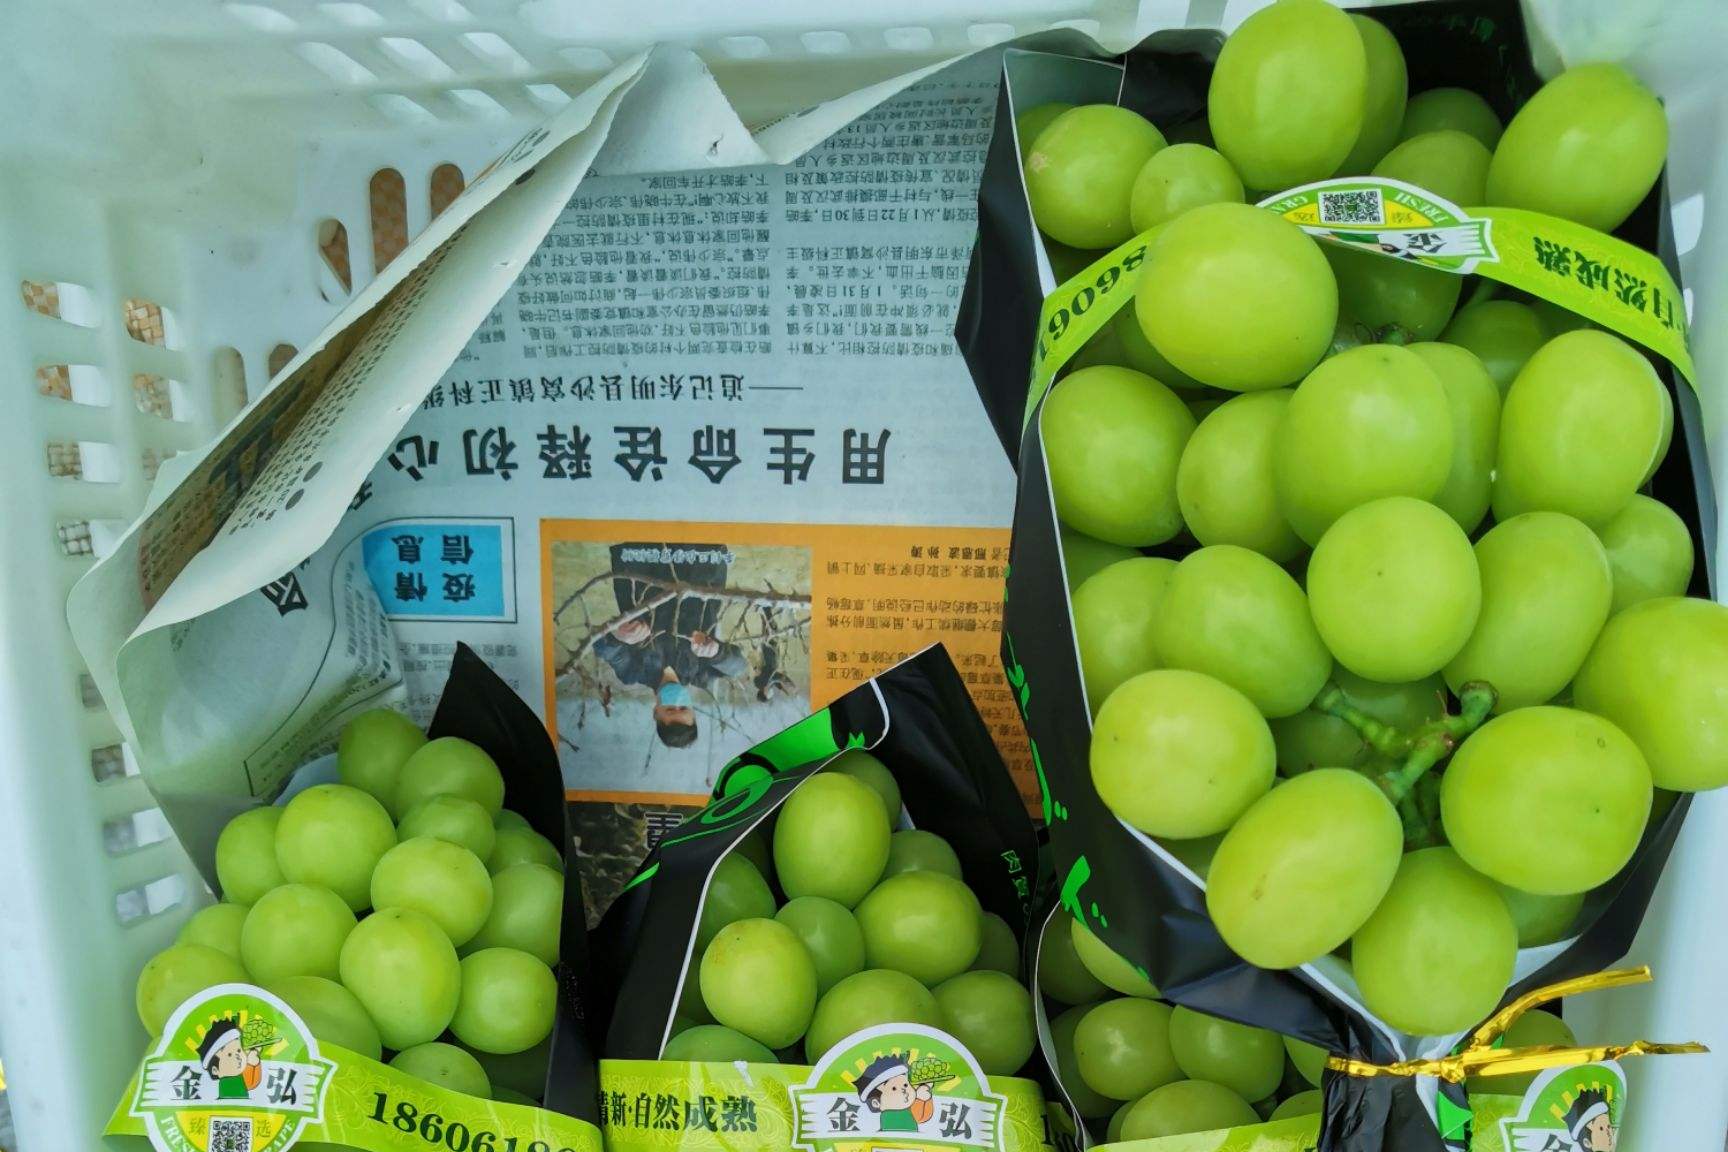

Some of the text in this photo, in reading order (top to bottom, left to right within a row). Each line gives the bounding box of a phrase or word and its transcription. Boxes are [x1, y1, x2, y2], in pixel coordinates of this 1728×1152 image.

[388, 424, 892, 486] 用生命诠释初心
[391, 535, 473, 565] 信息
[393, 572, 475, 603] 疫情
